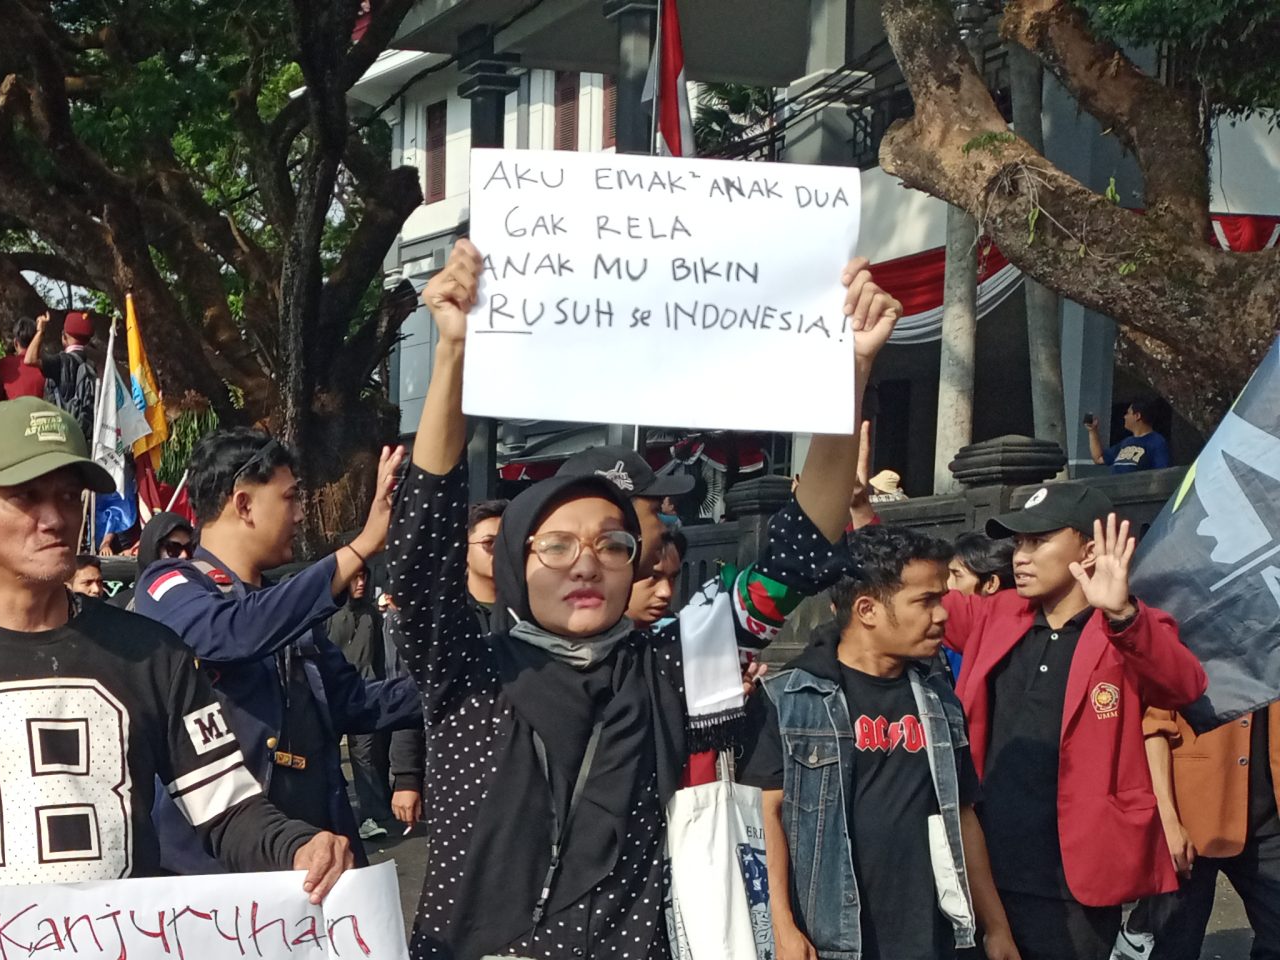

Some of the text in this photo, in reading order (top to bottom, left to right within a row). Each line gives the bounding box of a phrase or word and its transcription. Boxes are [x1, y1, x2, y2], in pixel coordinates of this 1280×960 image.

[483, 161, 564, 190] AKU
[795, 185, 849, 208] DUA
[505, 206, 692, 240] GAK RELA
[594, 254, 648, 281] MU
[673, 257, 759, 284] BIKIN
[489, 293, 614, 328] RUSUH
